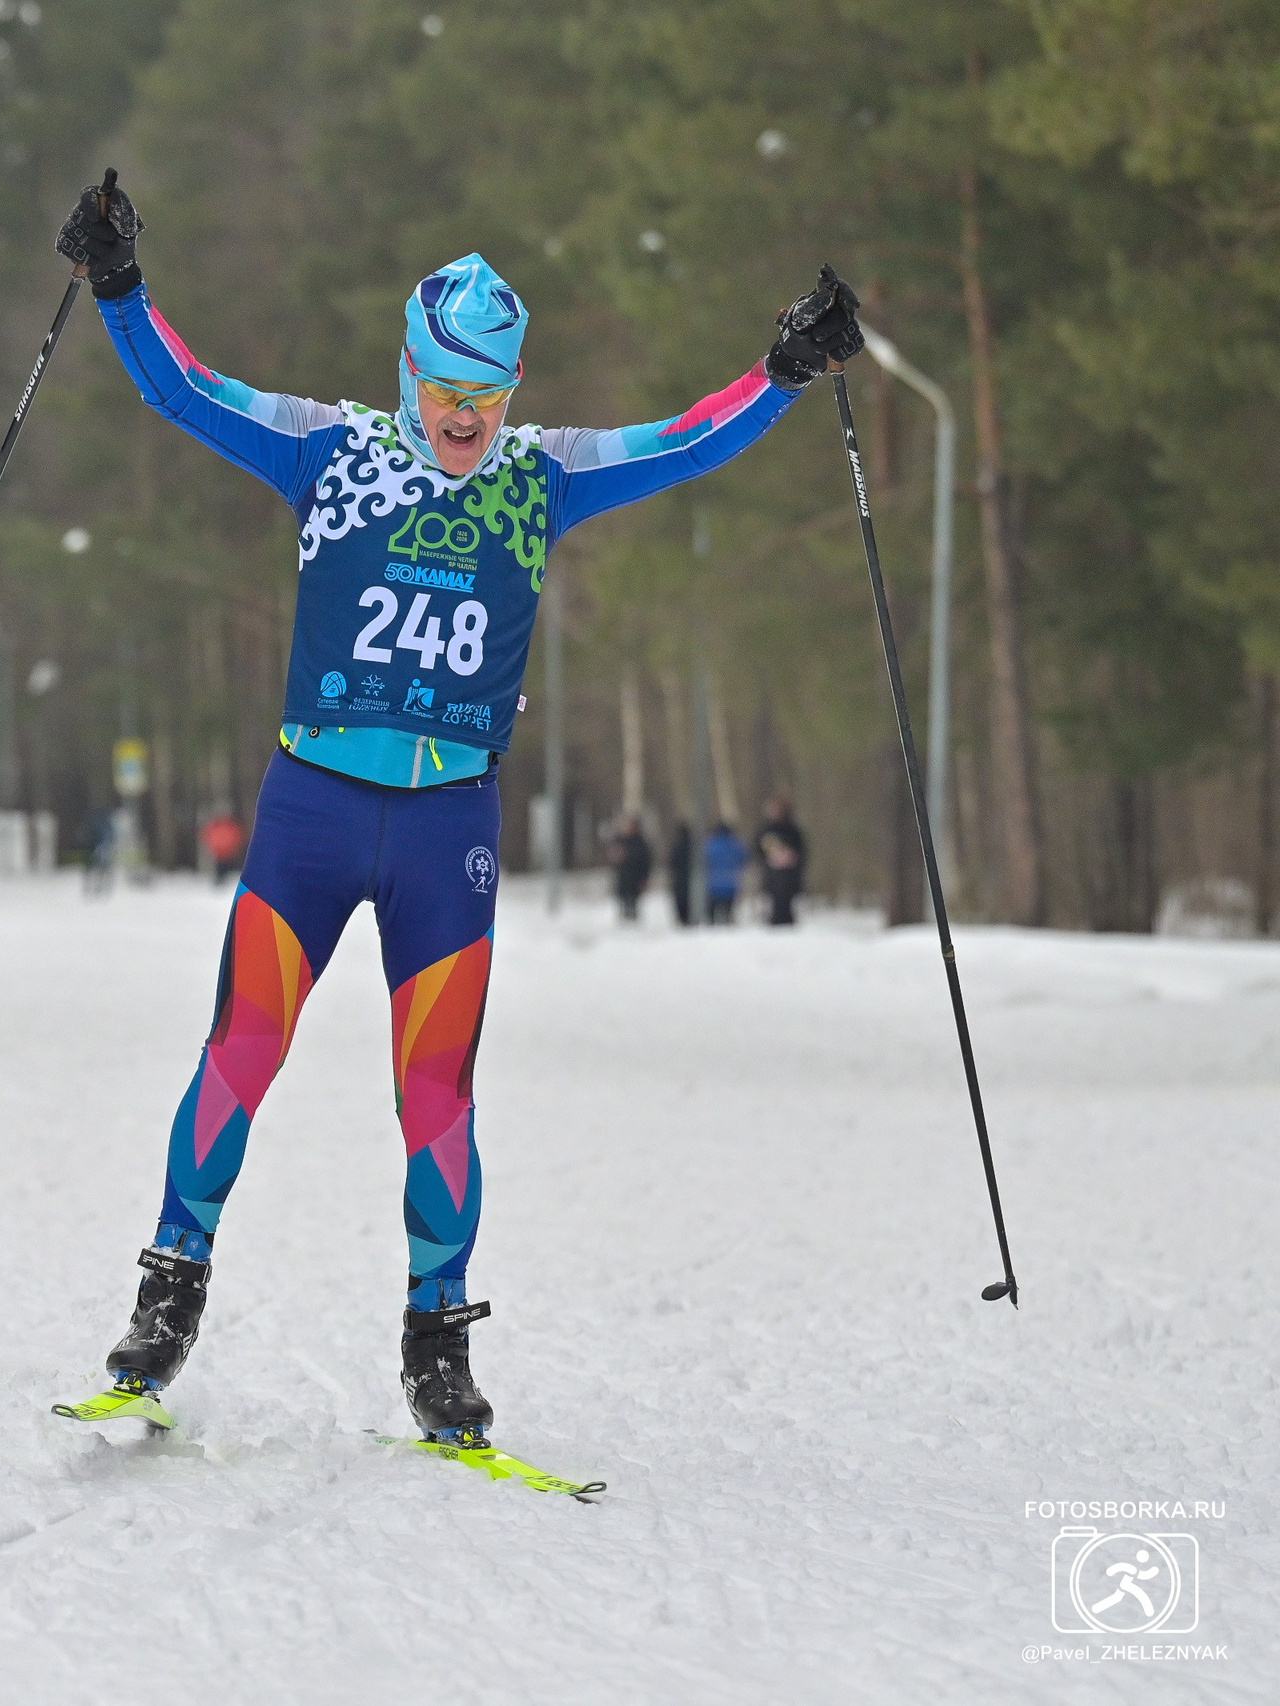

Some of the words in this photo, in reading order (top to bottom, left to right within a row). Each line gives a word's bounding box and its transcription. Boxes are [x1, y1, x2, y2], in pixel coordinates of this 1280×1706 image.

[848, 449, 870, 518] MADSHUS
[353, 585, 489, 676] 248
[142, 1254, 175, 1270] SPINE
[443, 1307, 481, 1323] SPINE
